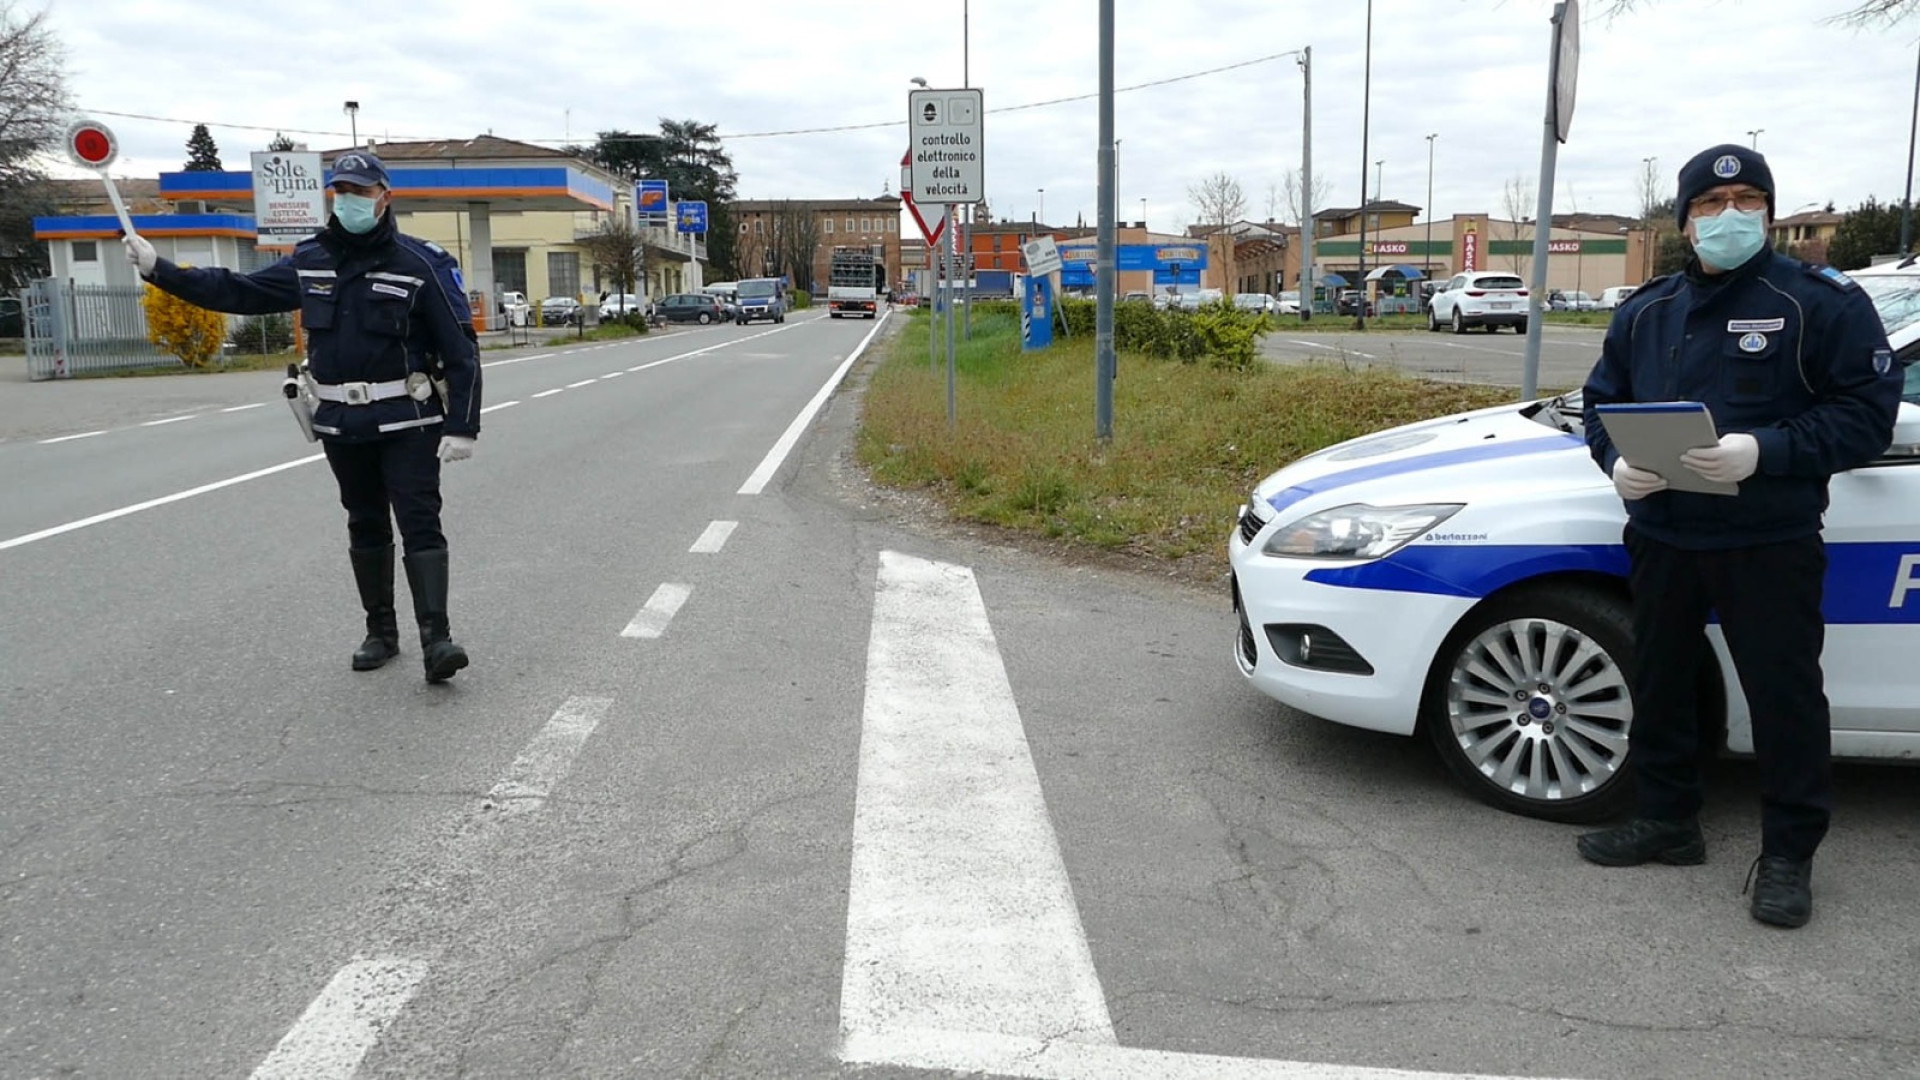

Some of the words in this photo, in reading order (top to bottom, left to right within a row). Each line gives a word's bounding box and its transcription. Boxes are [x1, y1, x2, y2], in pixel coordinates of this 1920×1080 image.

[922, 132, 971, 146] controllo
[917, 150, 976, 162] elettronico
[263, 160, 305, 178] Sole
[932, 166, 960, 179] della
[274, 179, 319, 194] Luna
